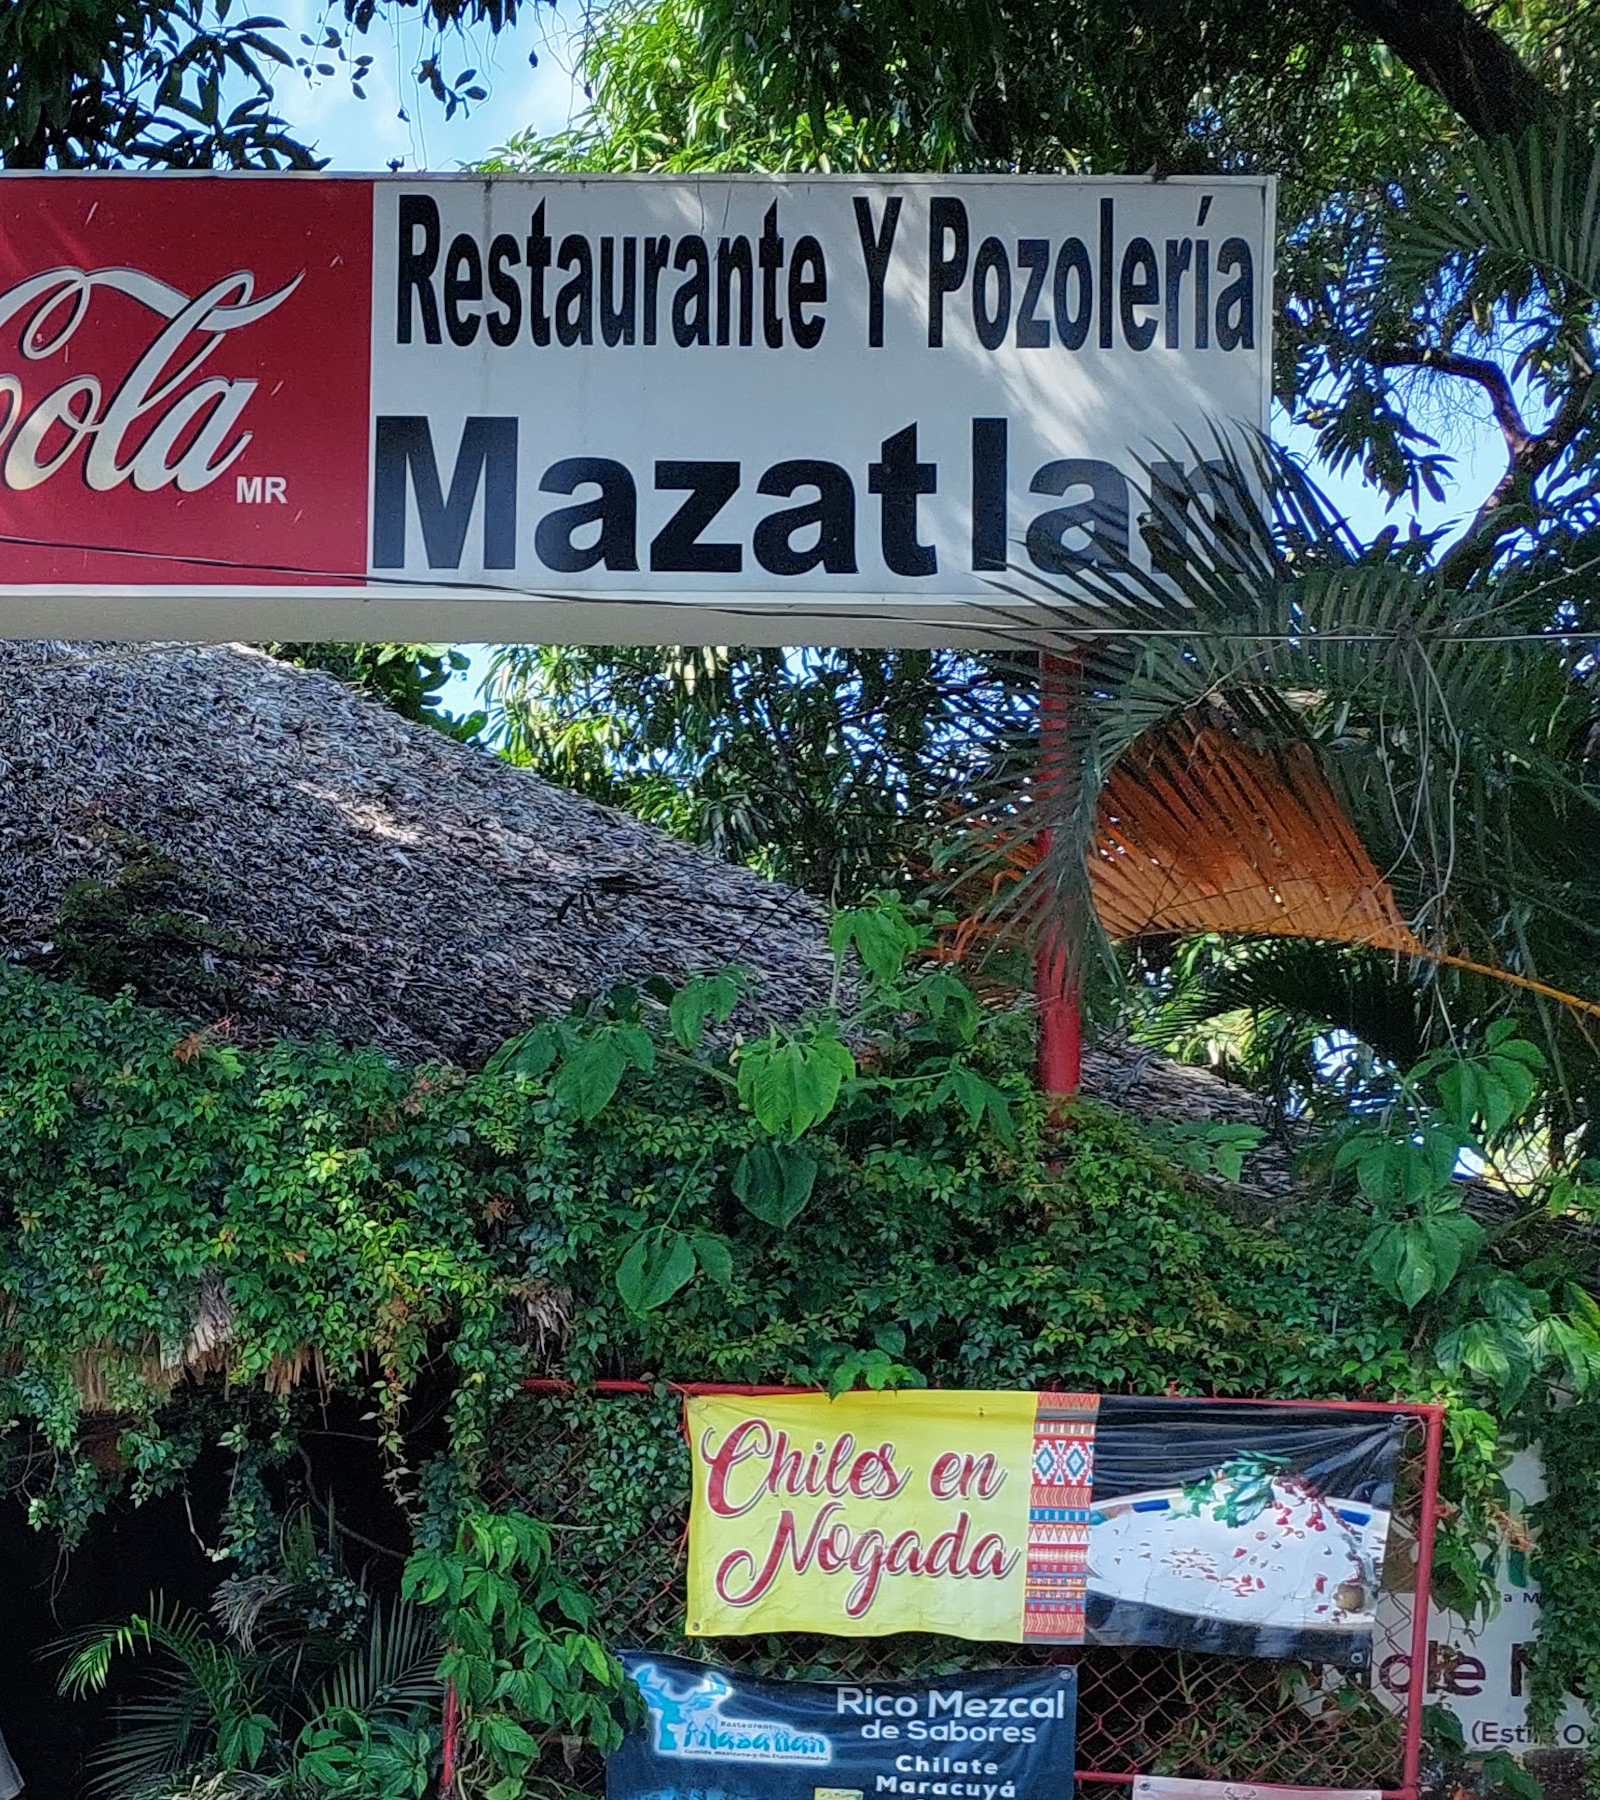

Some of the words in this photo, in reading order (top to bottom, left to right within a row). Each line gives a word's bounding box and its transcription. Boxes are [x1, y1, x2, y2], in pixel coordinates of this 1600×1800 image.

[397, 193, 829, 350] Restaurante
[852, 195, 903, 349] Y
[928, 194, 1257, 353] Pozolería
[235, 475, 288, 505] MR
[372, 415, 1237, 578] Mazatlan
[700, 1418, 912, 1517] Chiles
[929, 1449, 1011, 1500] en
[714, 1501, 1023, 1620] Nogada
[836, 1687, 918, 1718] Rico
[928, 1690, 1066, 1721] Mezcal
[861, 1719, 899, 1740] de
[906, 1720, 1037, 1744] Sabores
[895, 1755, 999, 1776] Chilate
[876, 1775, 1016, 1800] Maracuyá
